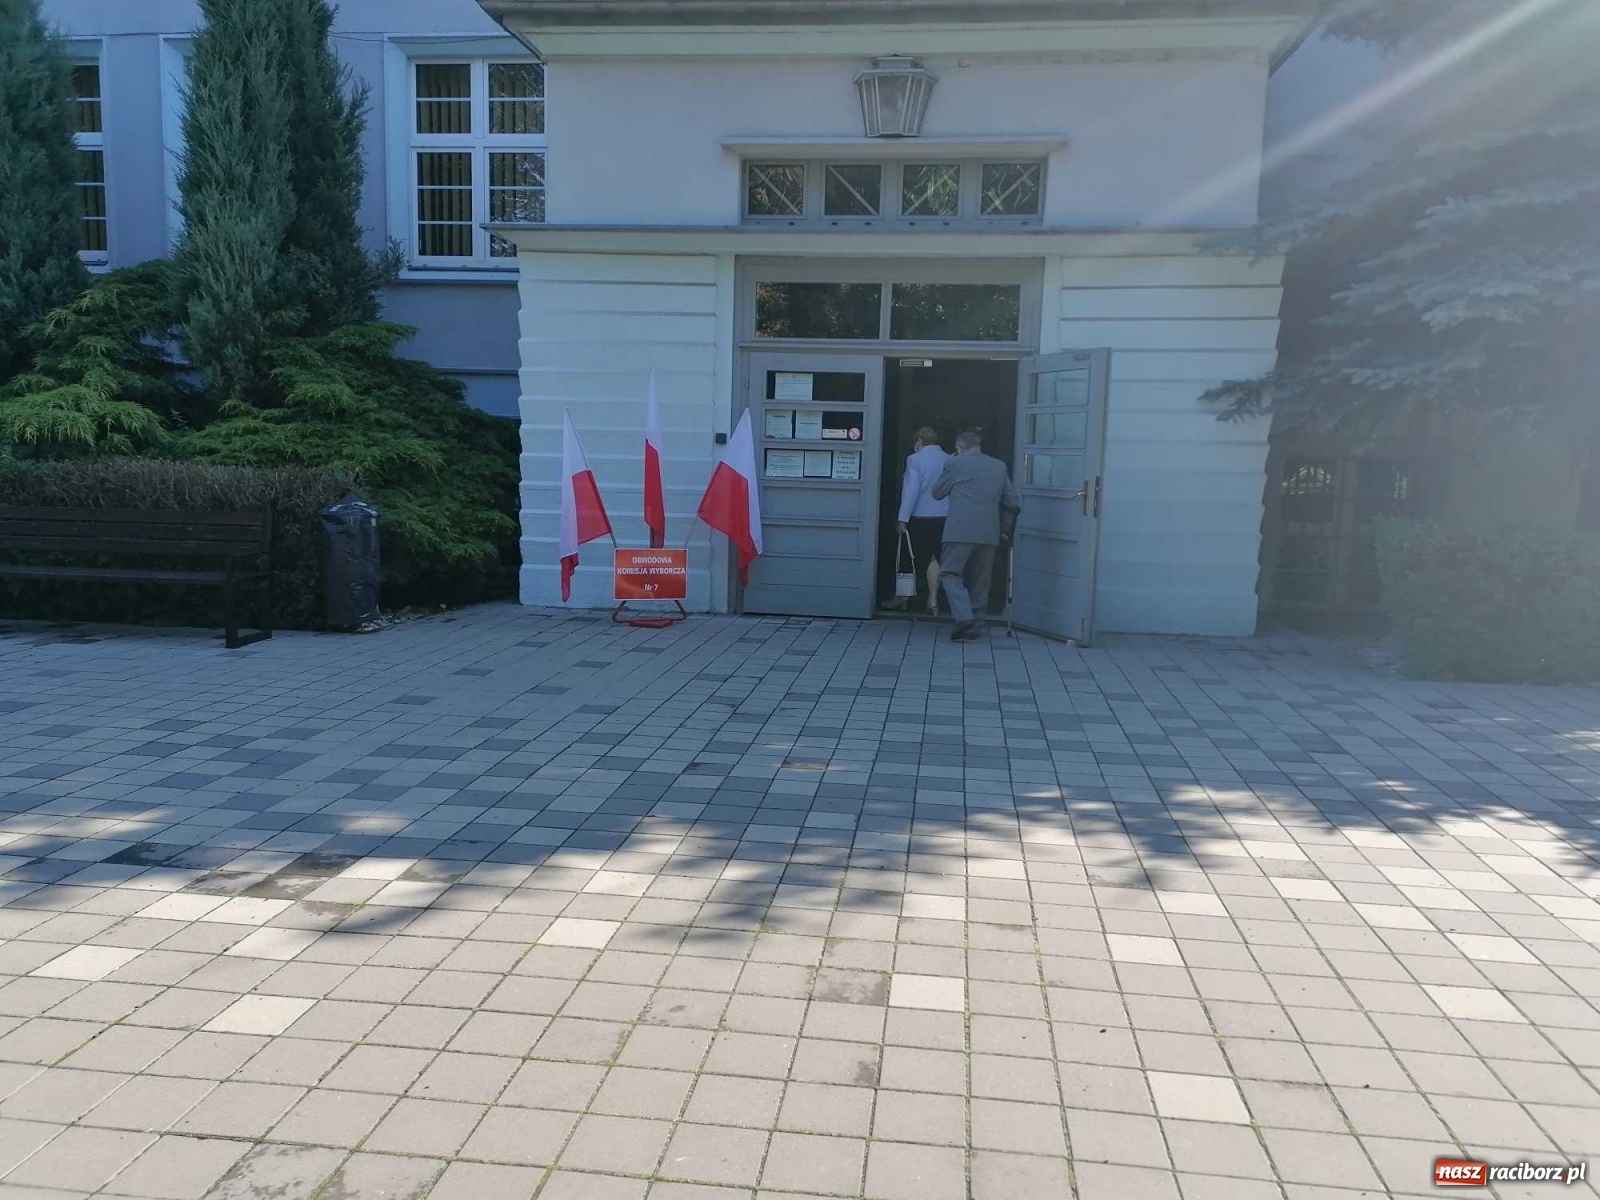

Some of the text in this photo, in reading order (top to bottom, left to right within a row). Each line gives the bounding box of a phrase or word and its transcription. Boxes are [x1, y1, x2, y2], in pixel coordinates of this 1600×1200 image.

[632, 556, 672, 564] OBWODOWA
[617, 567, 685, 575] KOMISJA WYBORCZA
[644, 583, 652, 591] Nr
